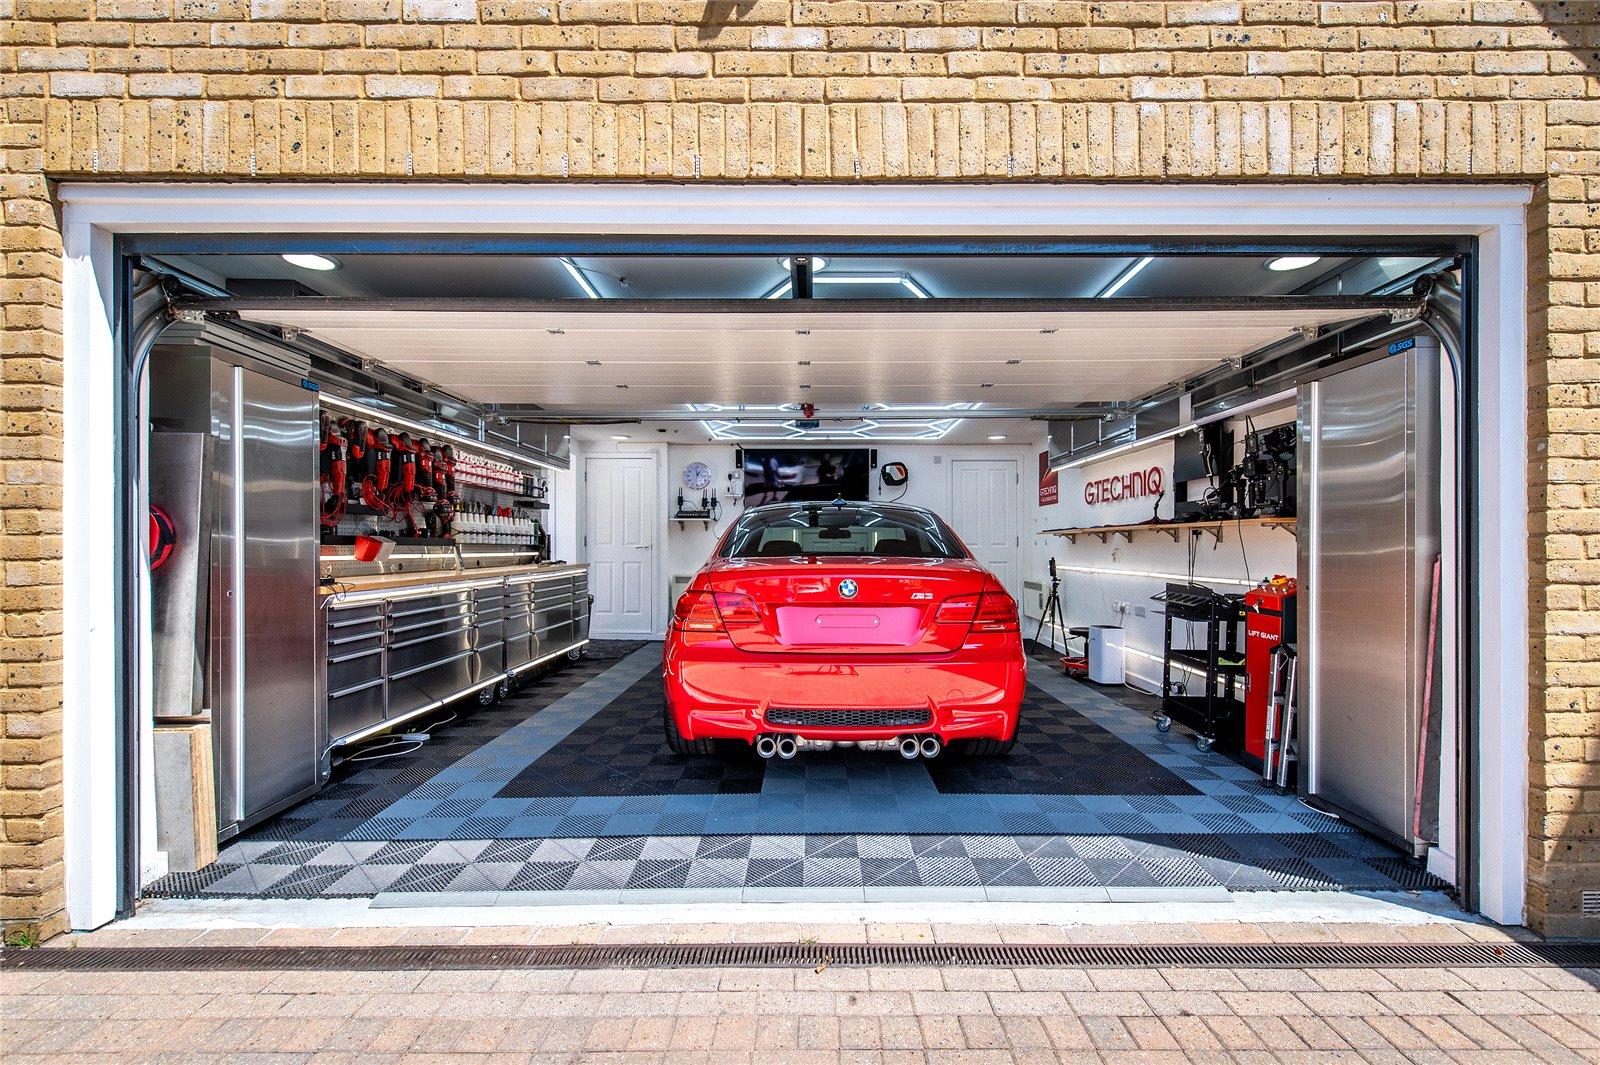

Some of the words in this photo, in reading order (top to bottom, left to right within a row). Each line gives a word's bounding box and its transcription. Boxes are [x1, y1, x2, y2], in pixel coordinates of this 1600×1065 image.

[1085, 467, 1162, 506] GTECHNIQ
[1248, 630, 1260, 638] LIFT
[1260, 632, 1279, 641] GIANT
